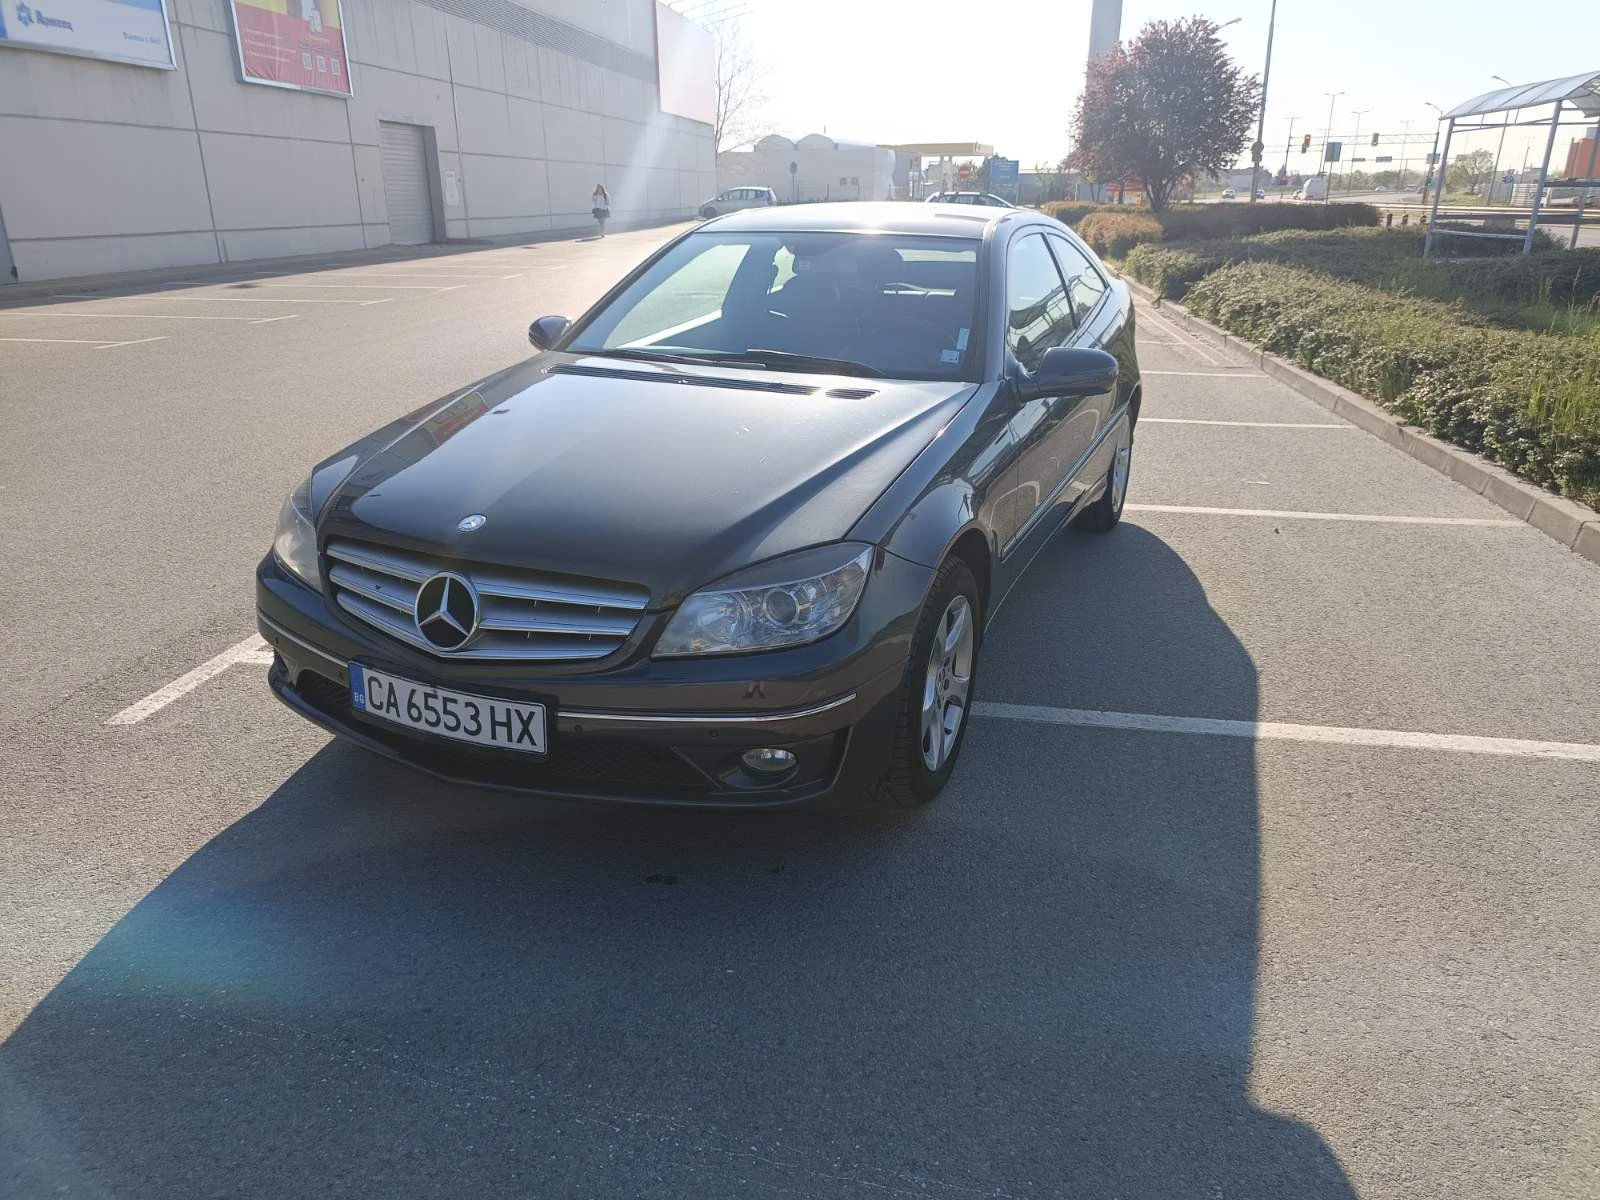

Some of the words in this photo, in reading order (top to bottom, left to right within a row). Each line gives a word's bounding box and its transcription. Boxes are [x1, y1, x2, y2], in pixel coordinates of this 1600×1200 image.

[354, 692, 365, 704] BG
[367, 676, 401, 718] CA
[406, 688, 482, 737] 6553
[489, 705, 537, 746] HX
